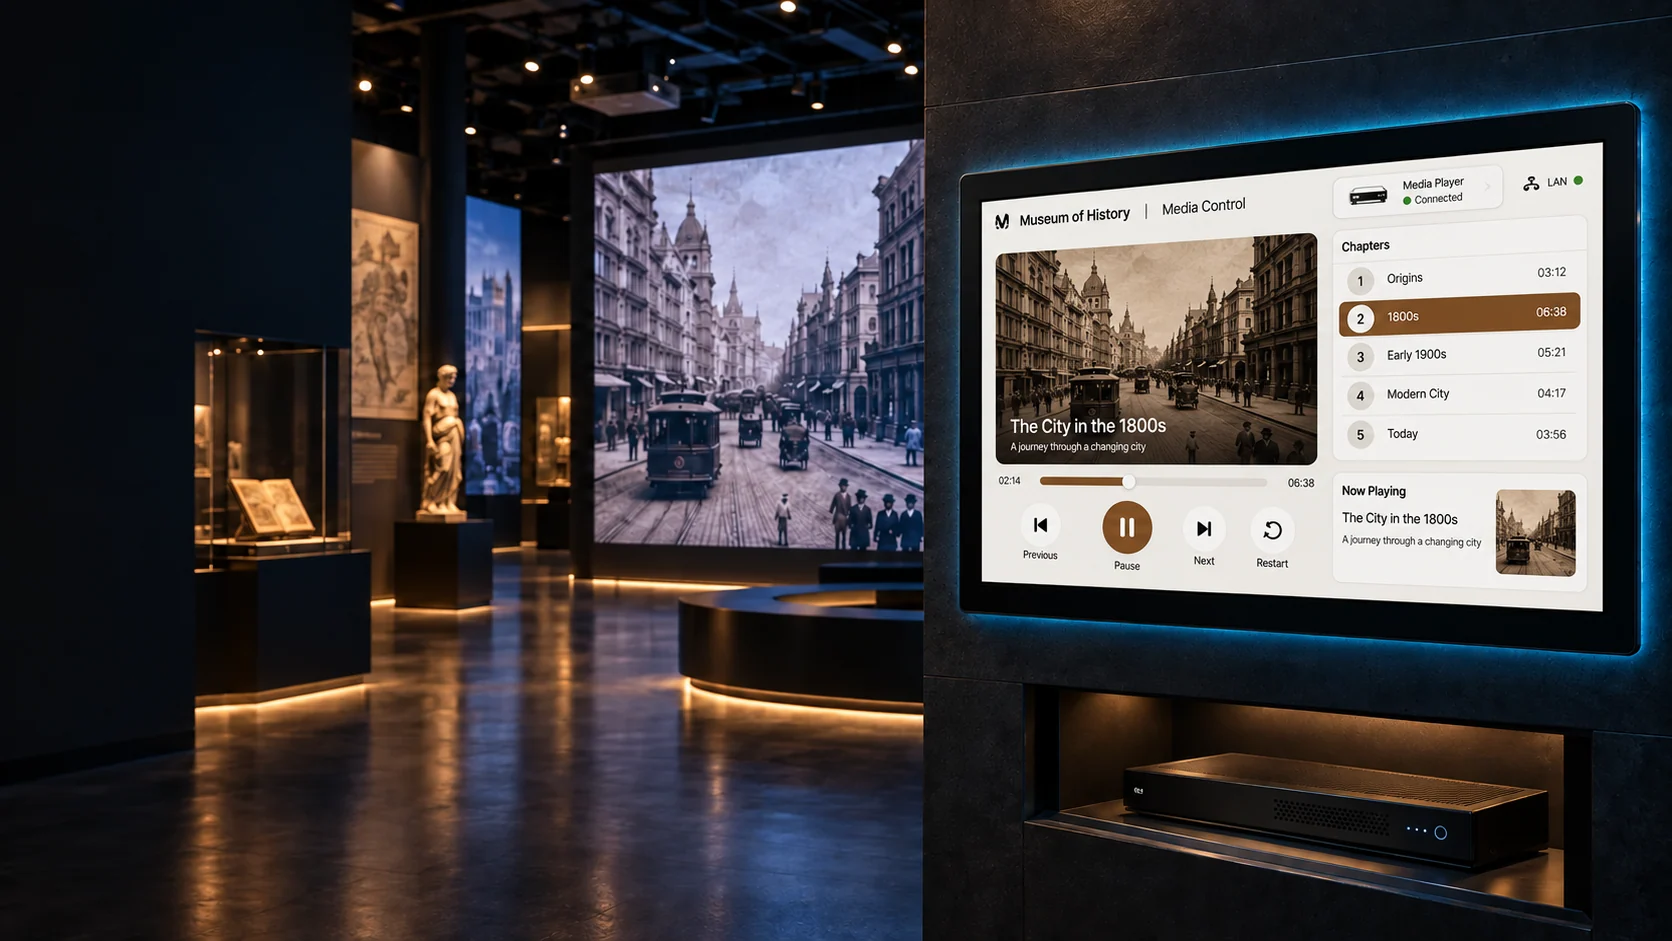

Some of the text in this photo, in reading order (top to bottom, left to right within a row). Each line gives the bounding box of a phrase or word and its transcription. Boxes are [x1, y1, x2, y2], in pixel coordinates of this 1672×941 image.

[1403, 177, 1465, 190] Media Player
[1547, 177, 1568, 187] LAN
[1414, 192, 1463, 205] Connected
[1162, 197, 1246, 216] Media Control
[1019, 207, 1131, 227] Museum of History
[1341, 240, 1390, 253] Chapters
[1537, 266, 1567, 278] 03:12
[1357, 276, 1364, 287] 1
[1387, 273, 1423, 285] Origins
[1387, 311, 1420, 322] 1800s
[1536, 306, 1567, 318] 06:38
[1356, 313, 1365, 325] 2
[1356, 352, 1365, 363] 3
[1387, 349, 1447, 362] Early 1900s
[1537, 347, 1567, 358] 05:21
[1356, 390, 1365, 401] 4
[1387, 387, 1450, 401] Modern City
[1537, 387, 1567, 399] 04:17
[1010, 417, 1167, 438] The City in the 1800s
[1356, 429, 1365, 441] 5
[1387, 428, 1419, 441] Today
[1536, 429, 1567, 440] 03:56
[1010, 441, 1146, 454] A journey through a changing city
[998, 475, 1021, 486] 02:14
[1287, 477, 1315, 488] 06:38
[1342, 485, 1406, 499] Now Playing
[1342, 511, 1458, 526] The City in the 1800s
[1342, 535, 1482, 550] A journey through a changing city
[1023, 550, 1058, 561] Previous
[1194, 555, 1215, 566] Next
[1114, 560, 1140, 571] Pause
[1256, 557, 1289, 569] Restart
